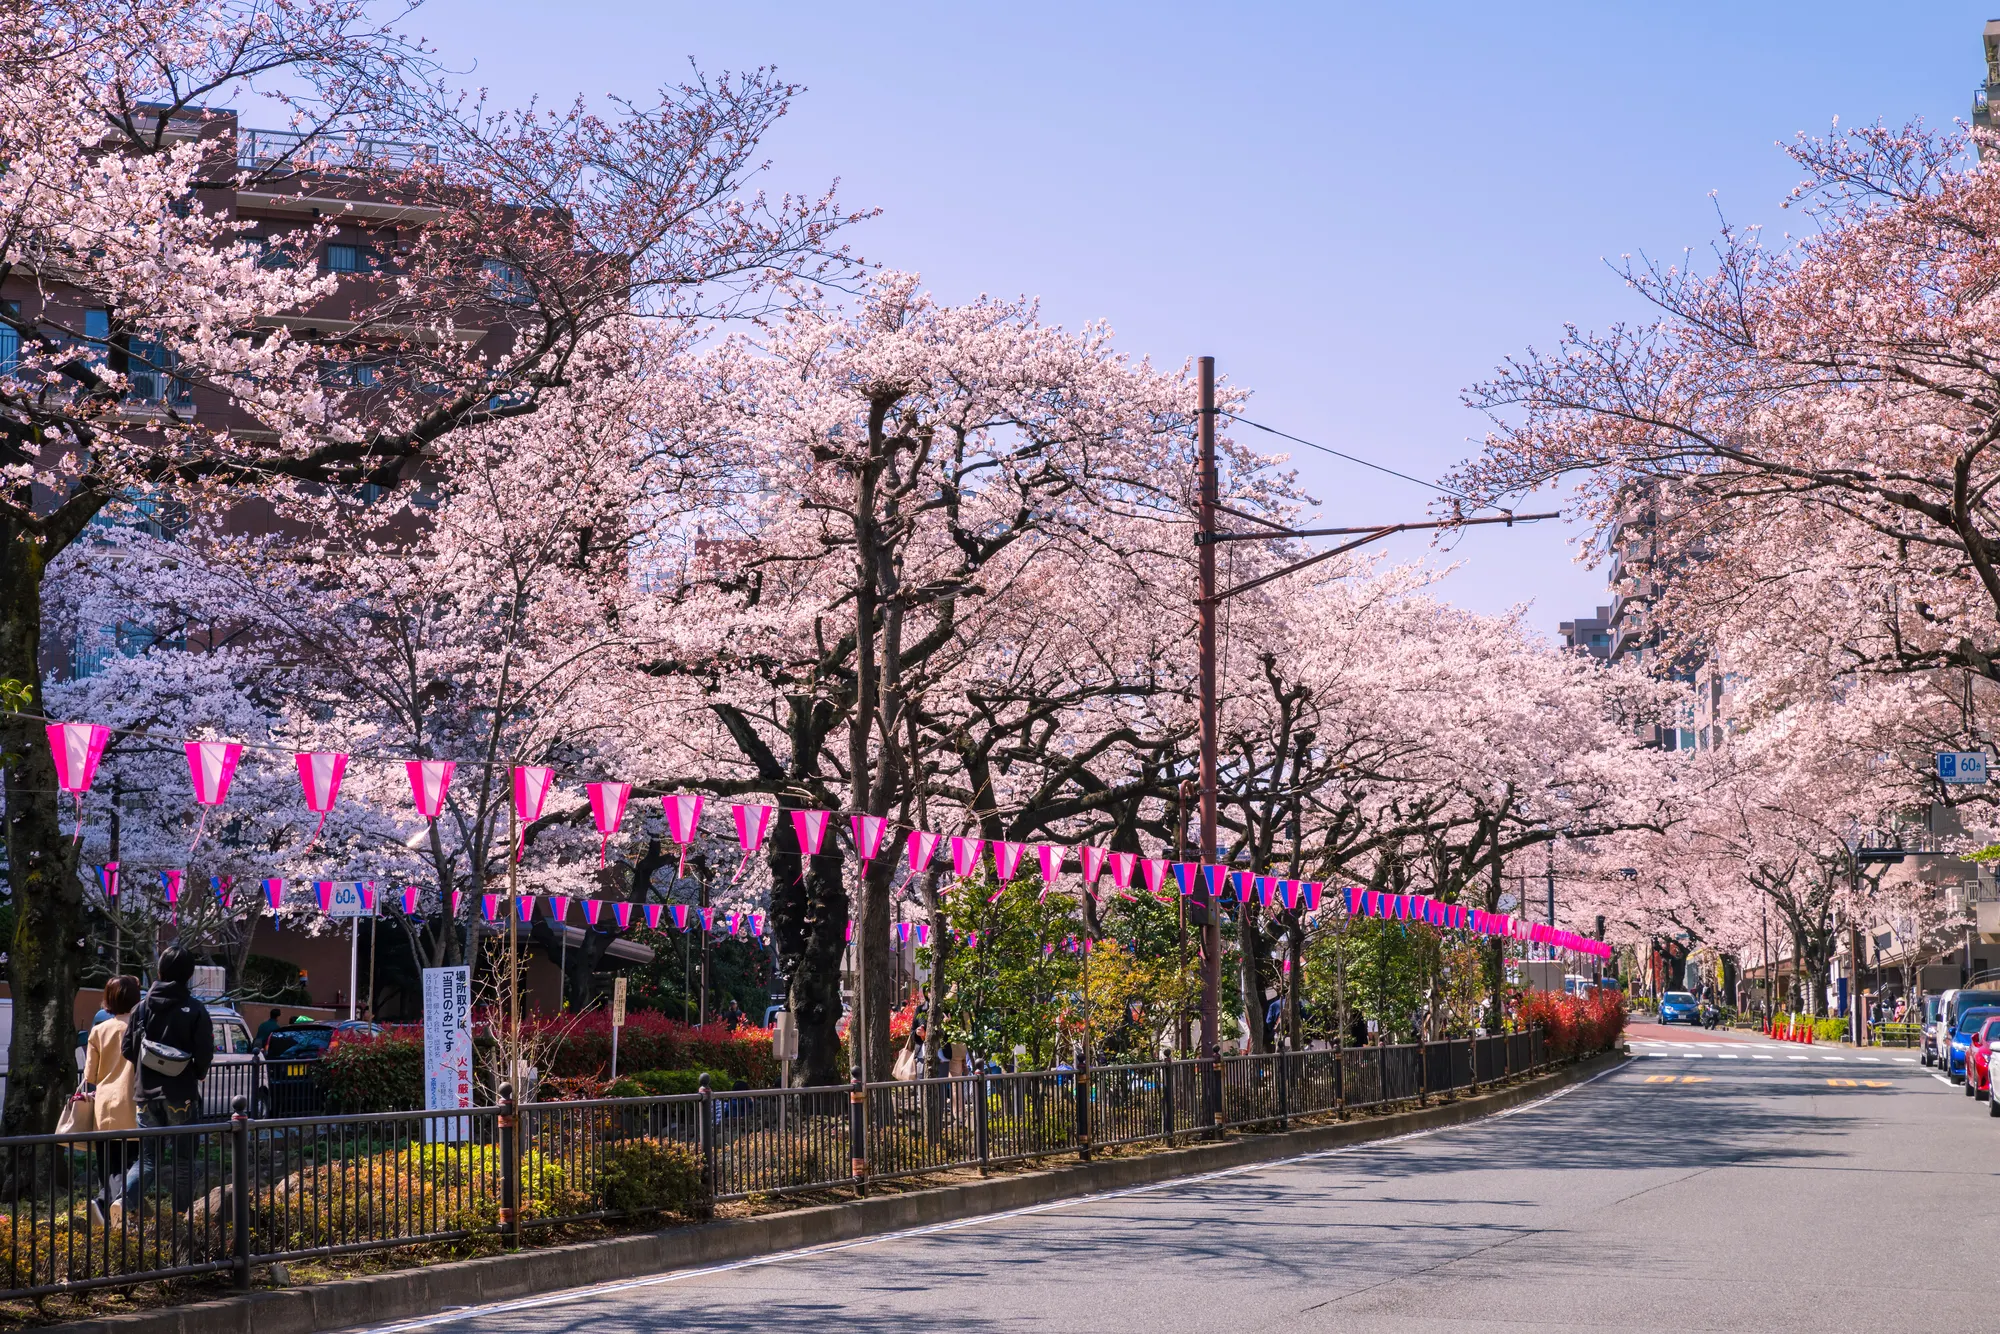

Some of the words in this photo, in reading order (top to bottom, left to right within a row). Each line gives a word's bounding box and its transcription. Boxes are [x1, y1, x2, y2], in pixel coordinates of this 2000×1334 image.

[1944, 756, 1952, 768] P
[1961, 758, 1981, 771] 60分
[336, 888, 355, 904] 60分
[442, 971, 454, 1053] 「当日のみ」です
[456, 970, 467, 1029] 場所取りは
[457, 1056, 469, 1108] 火気厳禁
